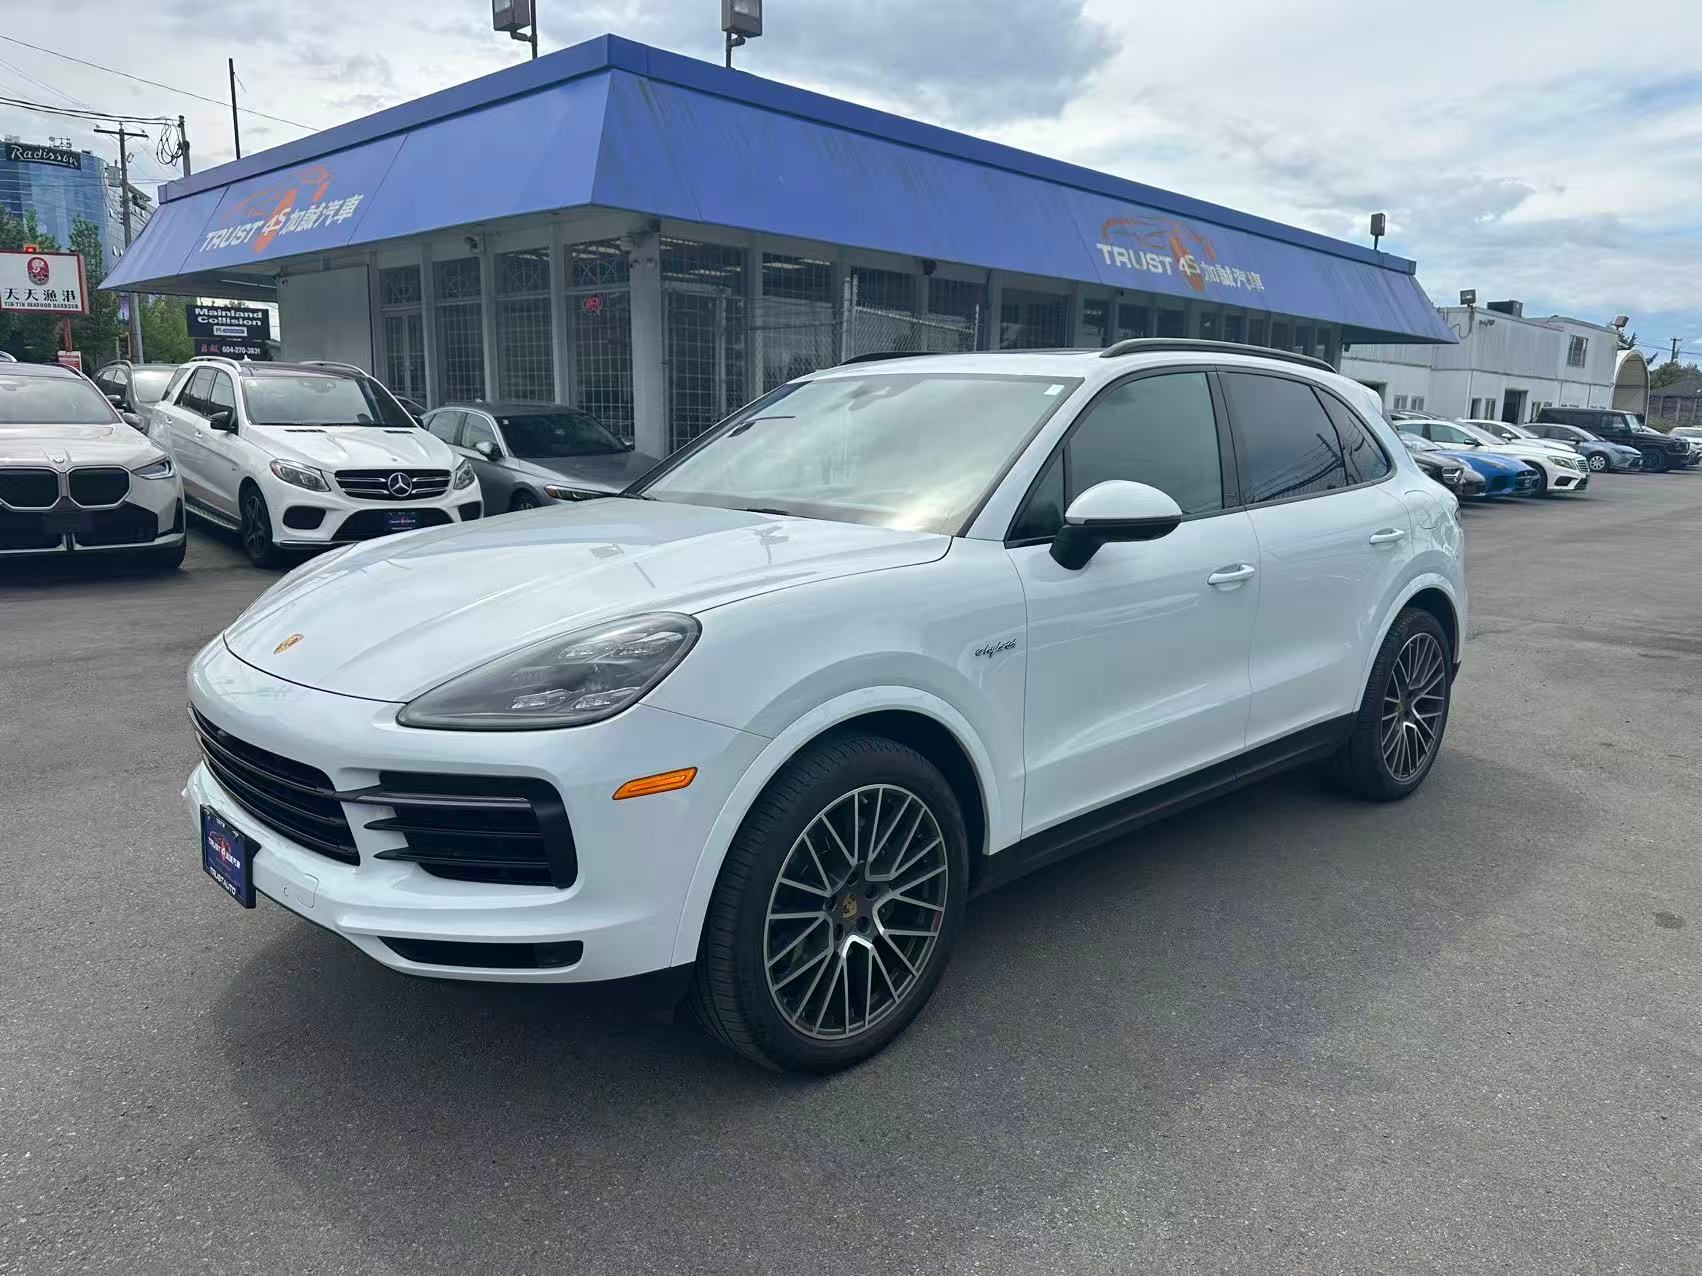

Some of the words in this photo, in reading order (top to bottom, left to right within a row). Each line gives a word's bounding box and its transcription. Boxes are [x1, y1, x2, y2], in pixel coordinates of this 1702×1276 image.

[11, 145, 78, 166] Radisson
[200, 220, 264, 252] TRUST
[261, 207, 291, 236] 4S
[1096, 243, 1173, 276] TRUST
[1178, 254, 1201, 277] 4S
[4, 288, 76, 302] 天天漁港
[194, 307, 263, 319] Mainland
[197, 315, 262, 326] Collision
